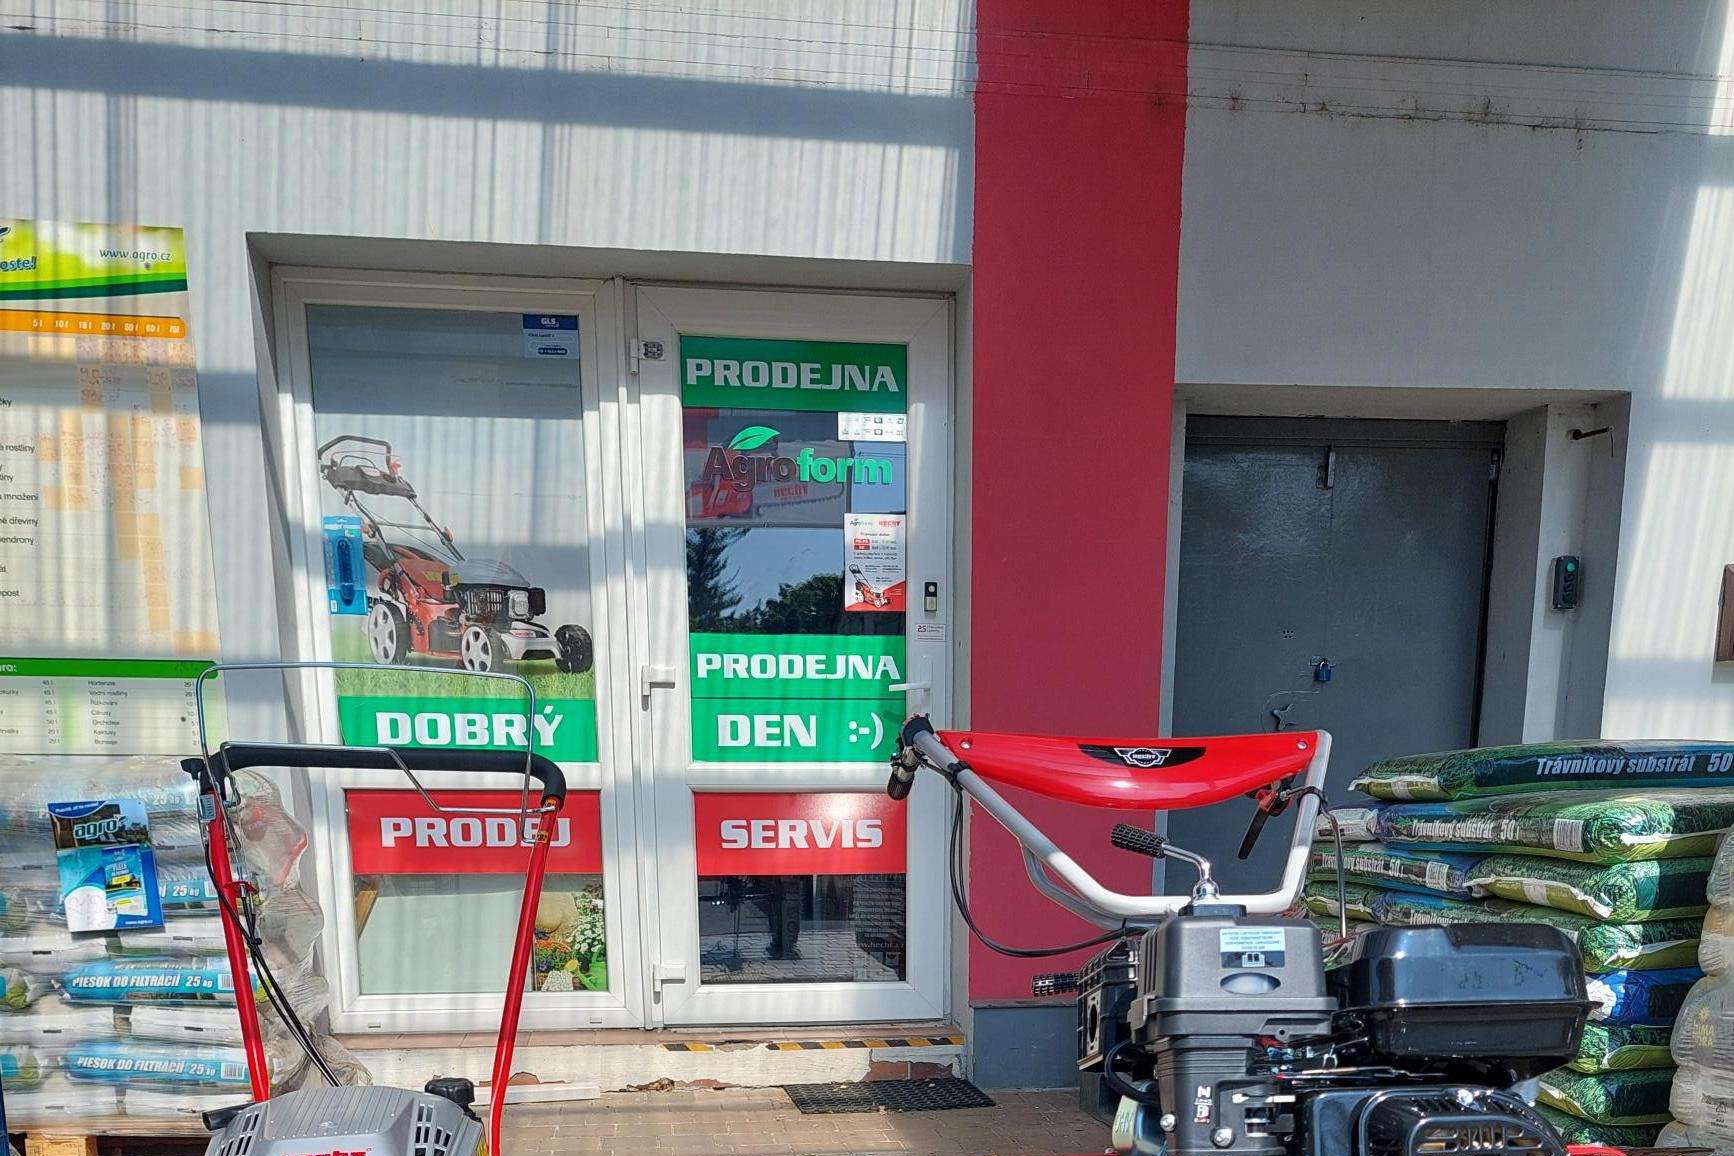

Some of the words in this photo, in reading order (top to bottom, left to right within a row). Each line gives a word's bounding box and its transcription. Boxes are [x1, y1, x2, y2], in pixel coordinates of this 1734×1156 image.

[98, 248, 171, 263] www.agro.cz
[541, 316, 557, 325] GLS
[685, 358, 900, 392] PRODEJNA
[701, 445, 893, 493] Agroform
[696, 652, 901, 680] PRODEJNA
[375, 705, 564, 746] DOBRÝ
[716, 714, 817, 748] DEN
[1535, 754, 1626, 775] Trávníkový
[1627, 754, 1696, 774] substrát
[73, 816, 119, 841] agro
[719, 818, 884, 849] SERVIS
[1500, 819, 1516, 840] 50
[1389, 858, 1401, 877] 50
[172, 884, 187, 896] 25
[72, 975, 112, 988] PIESOK
[113, 975, 129, 987] DO
[185, 975, 201, 988] 25
[202, 979, 213, 988] kg
[77, 1056, 116, 1070] PIESOK
[116, 1058, 132, 1070] DO
[188, 1063, 204, 1075] 25
[205, 1067, 216, 1076] kg
